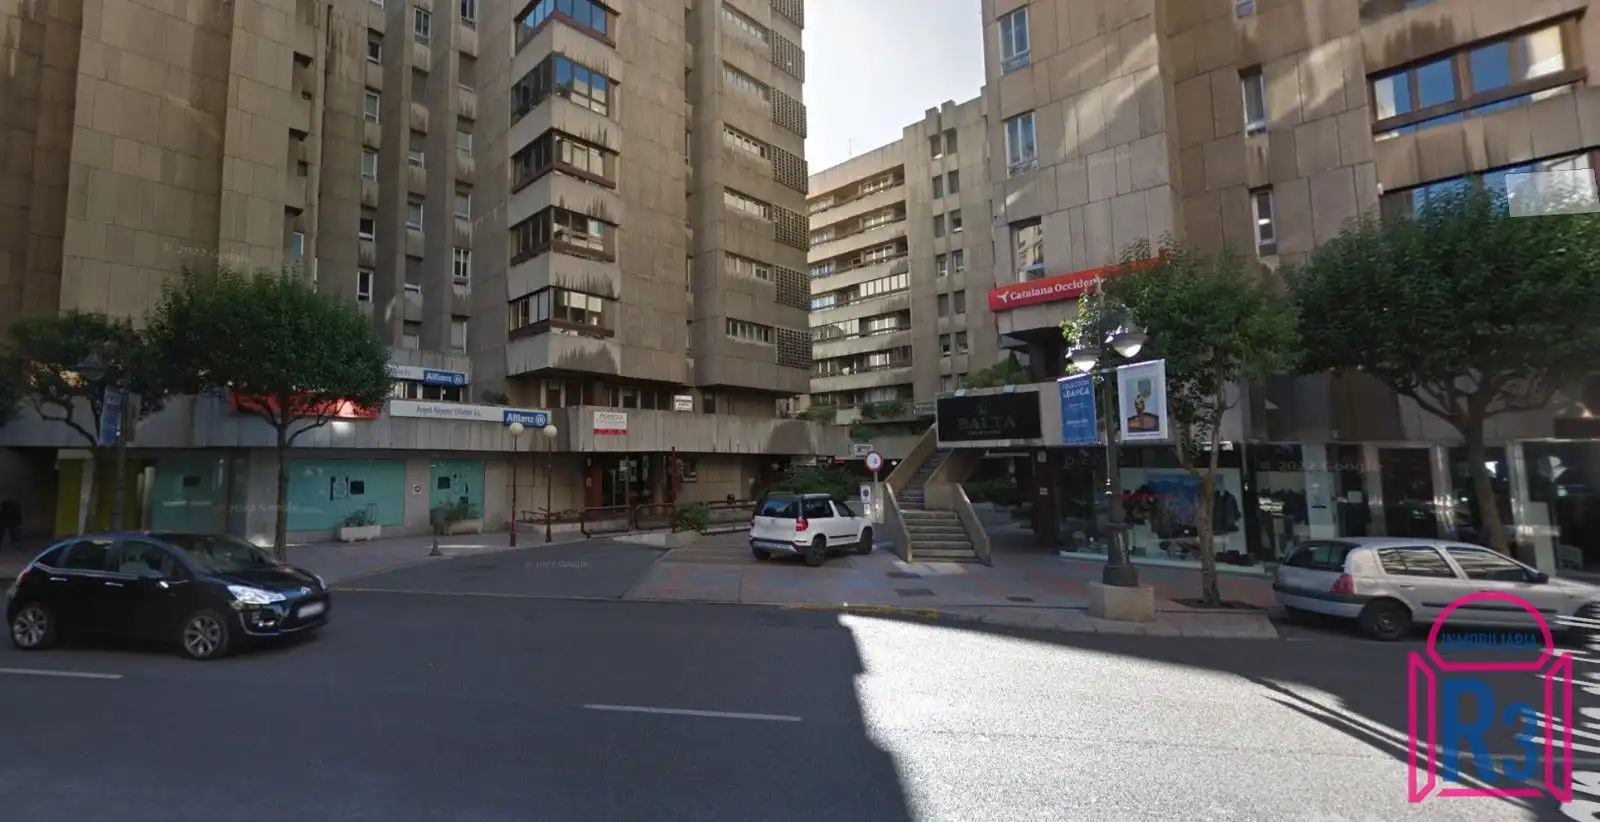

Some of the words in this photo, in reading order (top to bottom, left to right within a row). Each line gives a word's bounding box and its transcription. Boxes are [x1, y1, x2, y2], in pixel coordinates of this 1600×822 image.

[1009, 286, 1053, 301] Catalana
[426, 372, 452, 383] Allianz
[507, 413, 534, 424] Allianz
[957, 414, 1017, 431] BALTA
